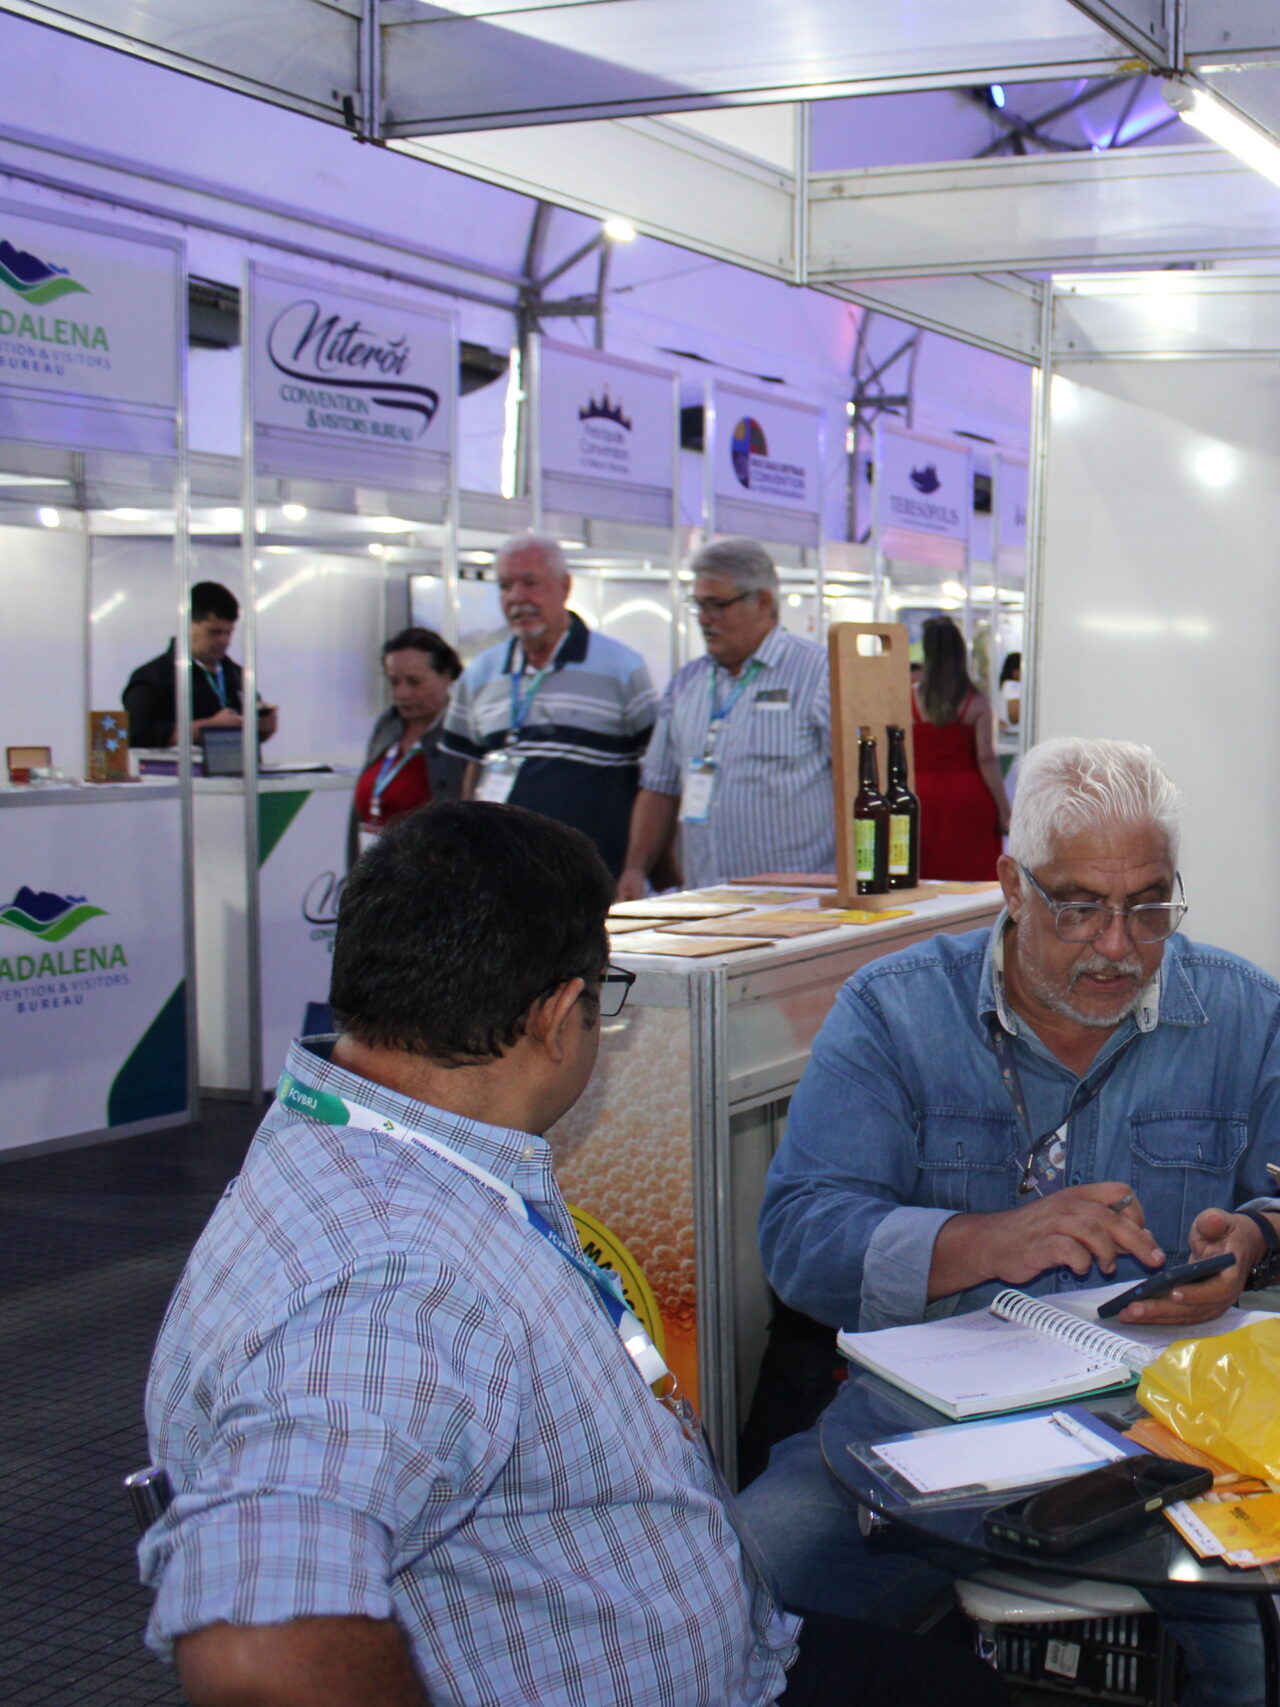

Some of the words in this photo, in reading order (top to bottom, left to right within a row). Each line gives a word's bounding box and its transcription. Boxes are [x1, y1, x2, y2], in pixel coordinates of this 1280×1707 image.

[53, 351, 112, 369] VISITORS
[280, 385, 368, 414] CONVENTION
[307, 408, 318, 428] &
[320, 413, 368, 433] VISITORS
[372, 422, 413, 441] BUREAU
[60, 982, 68, 993] &
[72, 974, 129, 991] VISITORS
[17, 994, 84, 1013] BUREAU
[289, 1088, 318, 1109] FCVBRJ
[410, 1137, 441, 1159] FEDERAÇÃO
